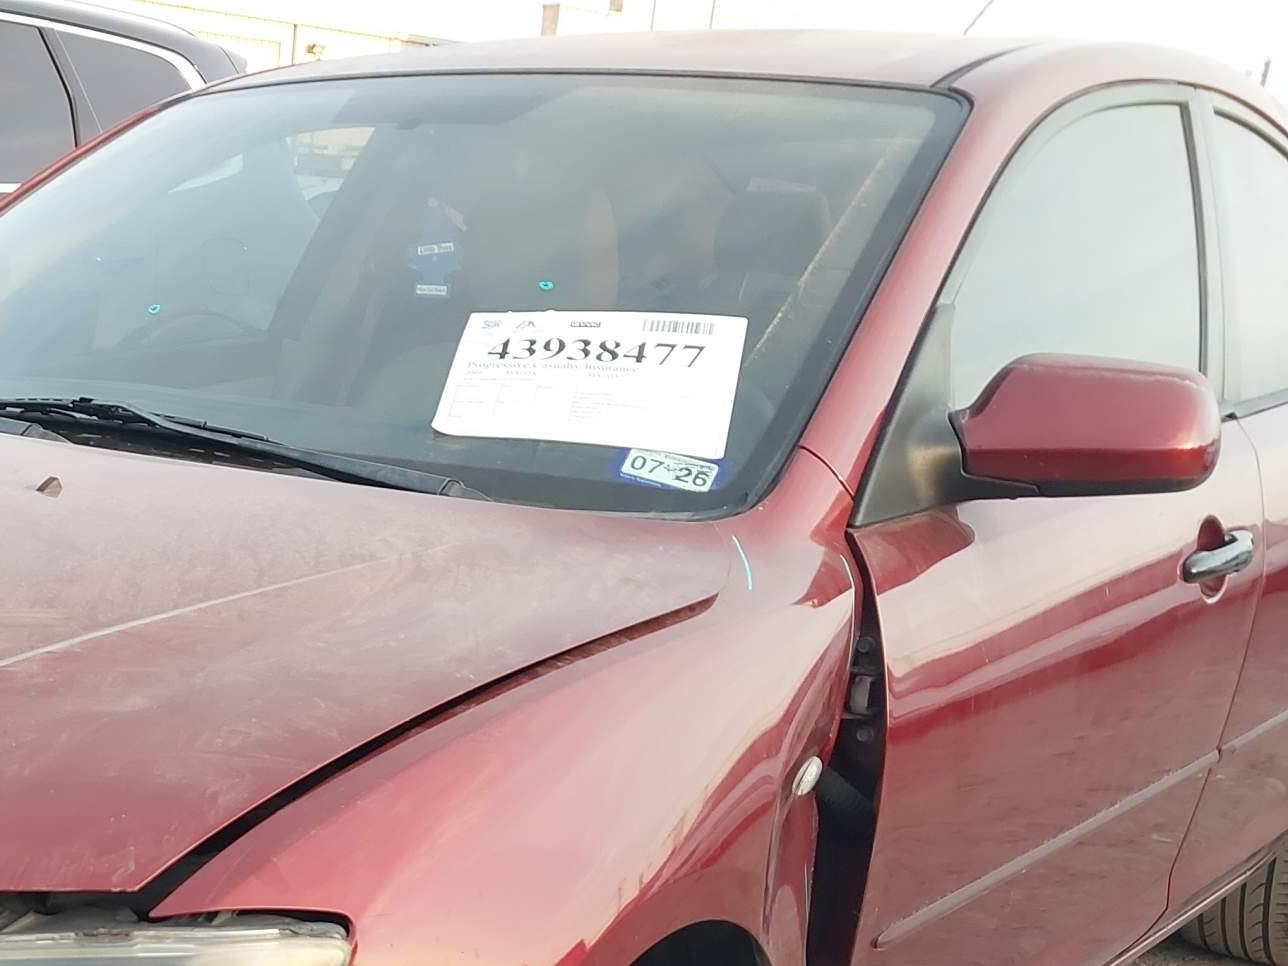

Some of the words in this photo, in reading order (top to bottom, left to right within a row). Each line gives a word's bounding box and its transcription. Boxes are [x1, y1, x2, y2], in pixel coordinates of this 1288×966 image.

[487, 336, 707, 368] 43938477
[630, 455, 665, 474] 07
[672, 466, 710, 487] 26
